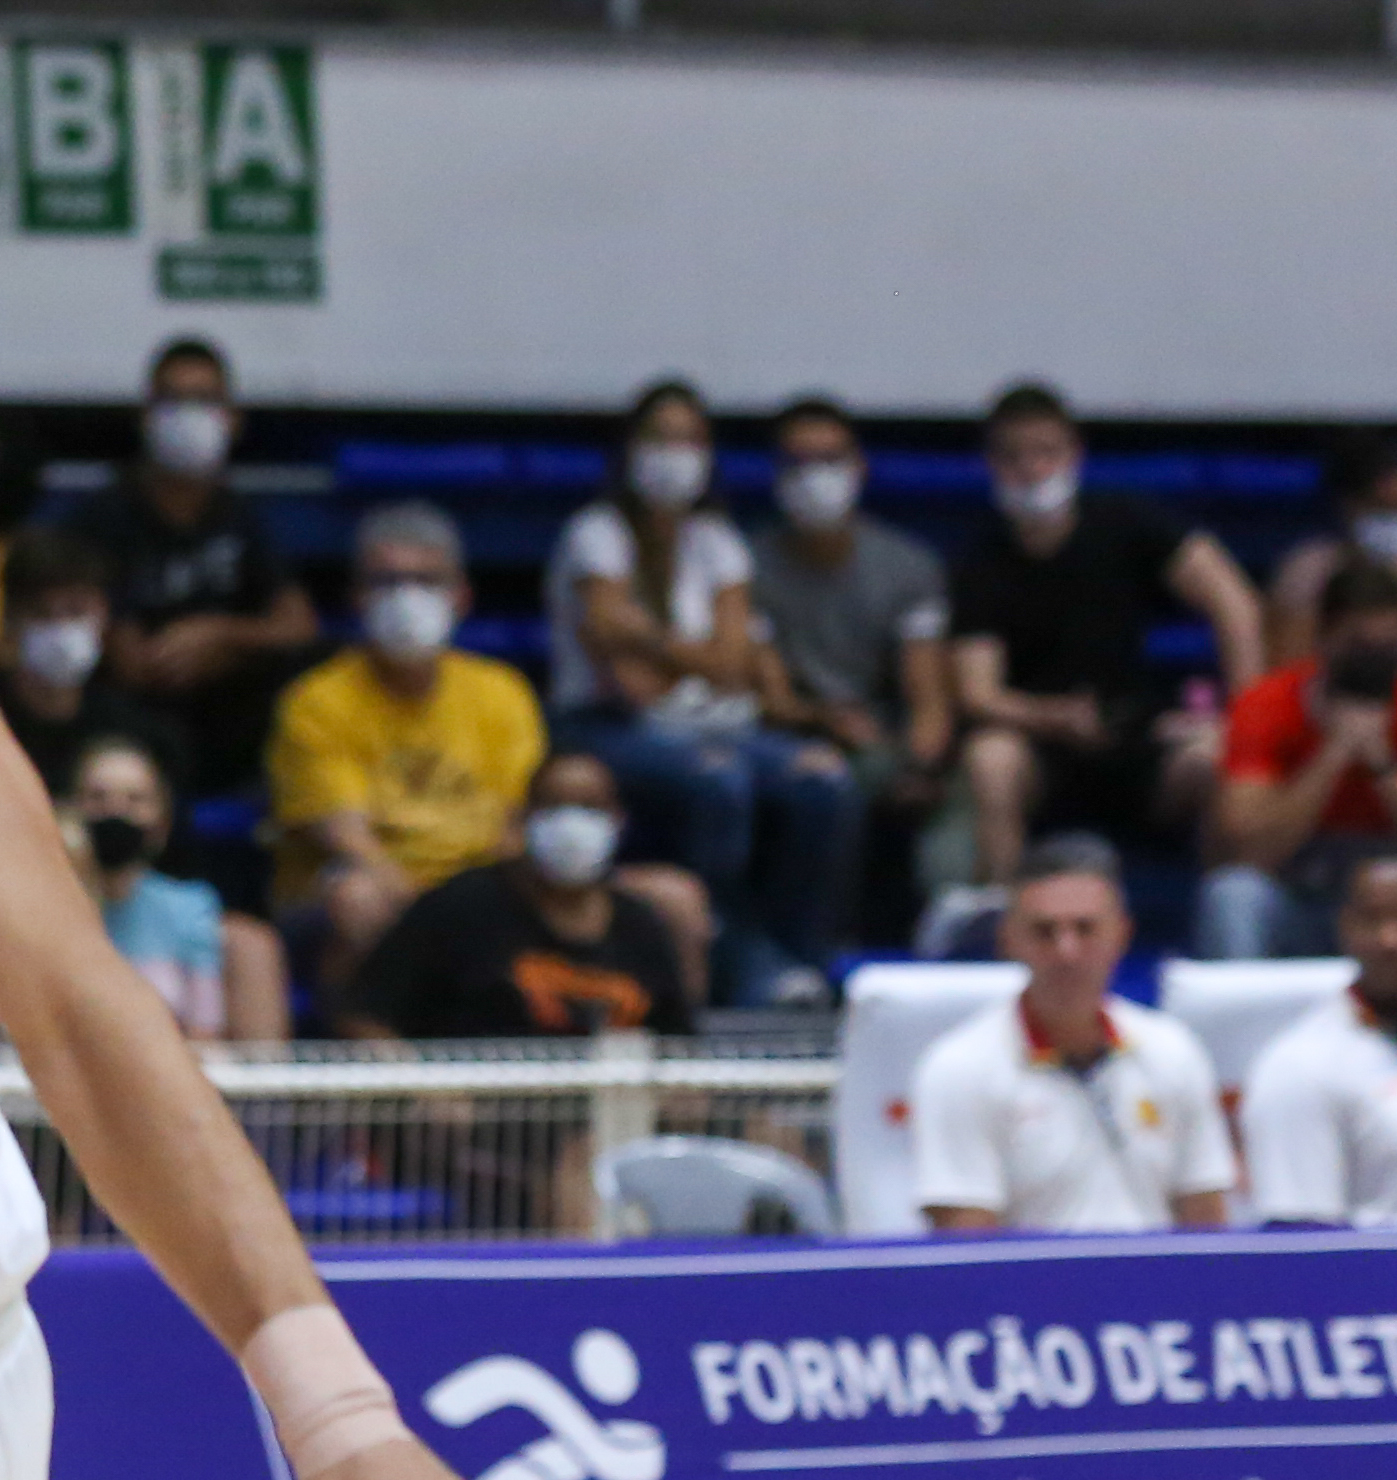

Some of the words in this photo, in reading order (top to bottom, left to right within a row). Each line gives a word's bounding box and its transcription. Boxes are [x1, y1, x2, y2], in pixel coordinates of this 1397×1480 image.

[29, 52, 119, 174] B
[213, 52, 307, 182] A
[692, 1316, 1099, 1436] FORMAÇÃO
[1098, 1321, 1208, 1404] DE
